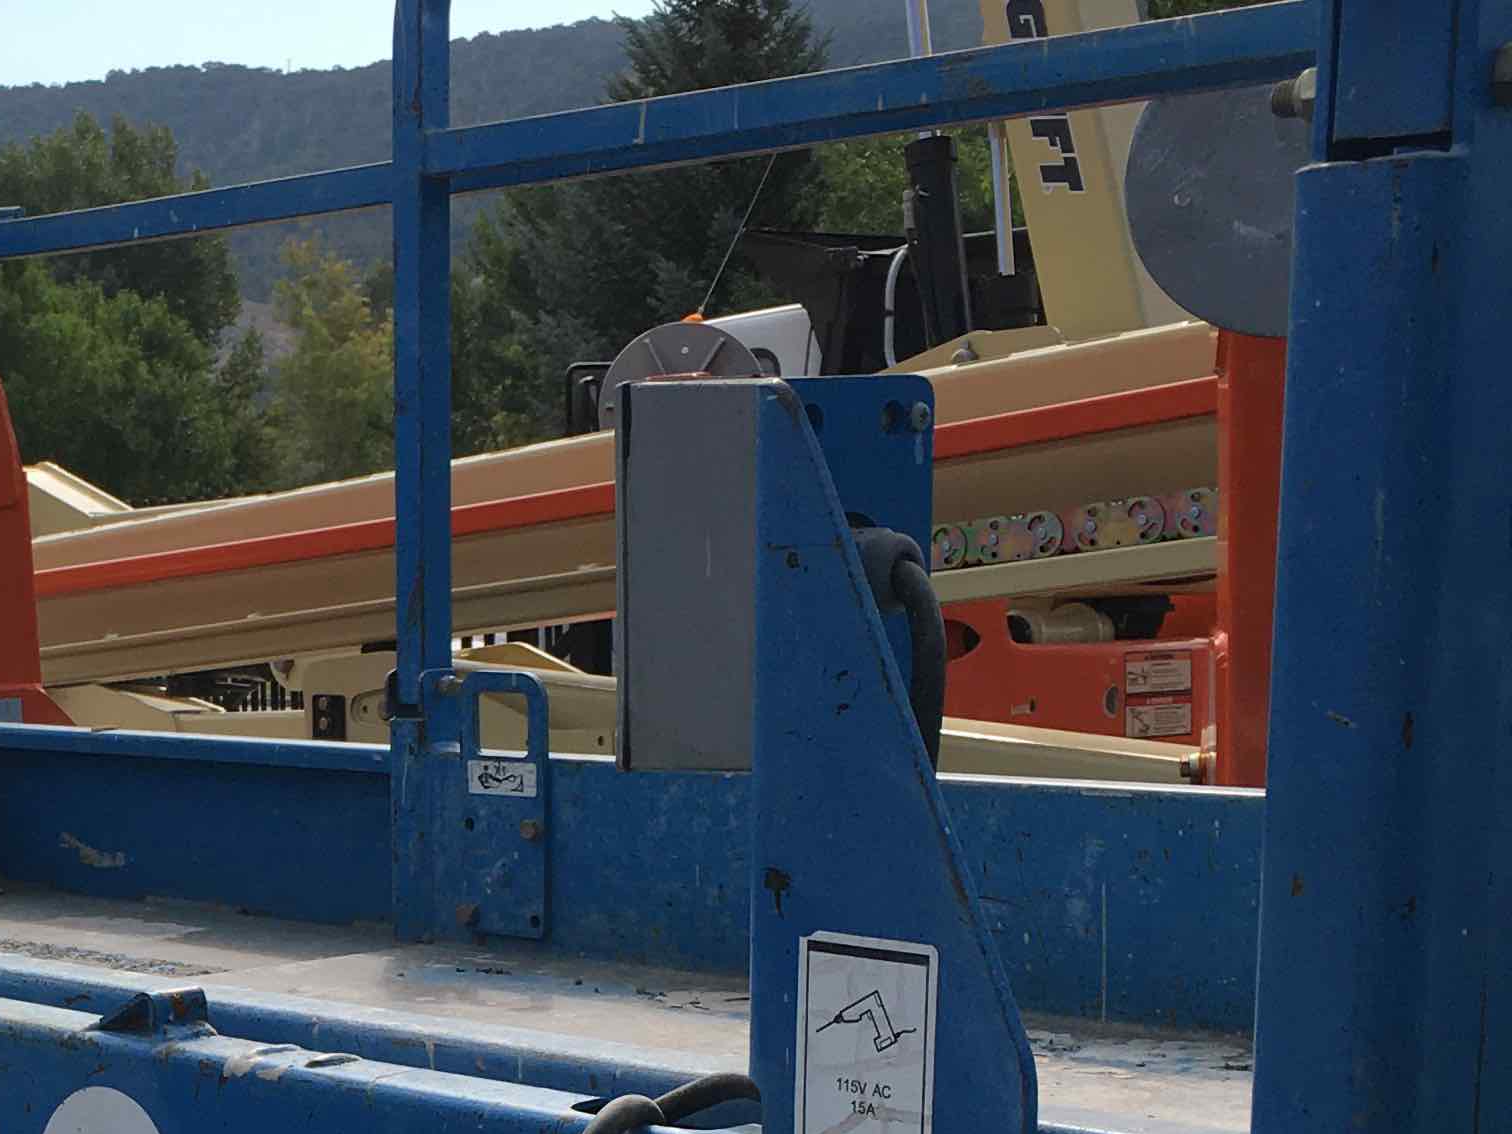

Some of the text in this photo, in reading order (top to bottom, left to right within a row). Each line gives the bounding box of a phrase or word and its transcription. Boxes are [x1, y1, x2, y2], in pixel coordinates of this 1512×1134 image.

[835, 1077, 892, 1099] 115V AC
[851, 1100, 876, 1117] 15A
